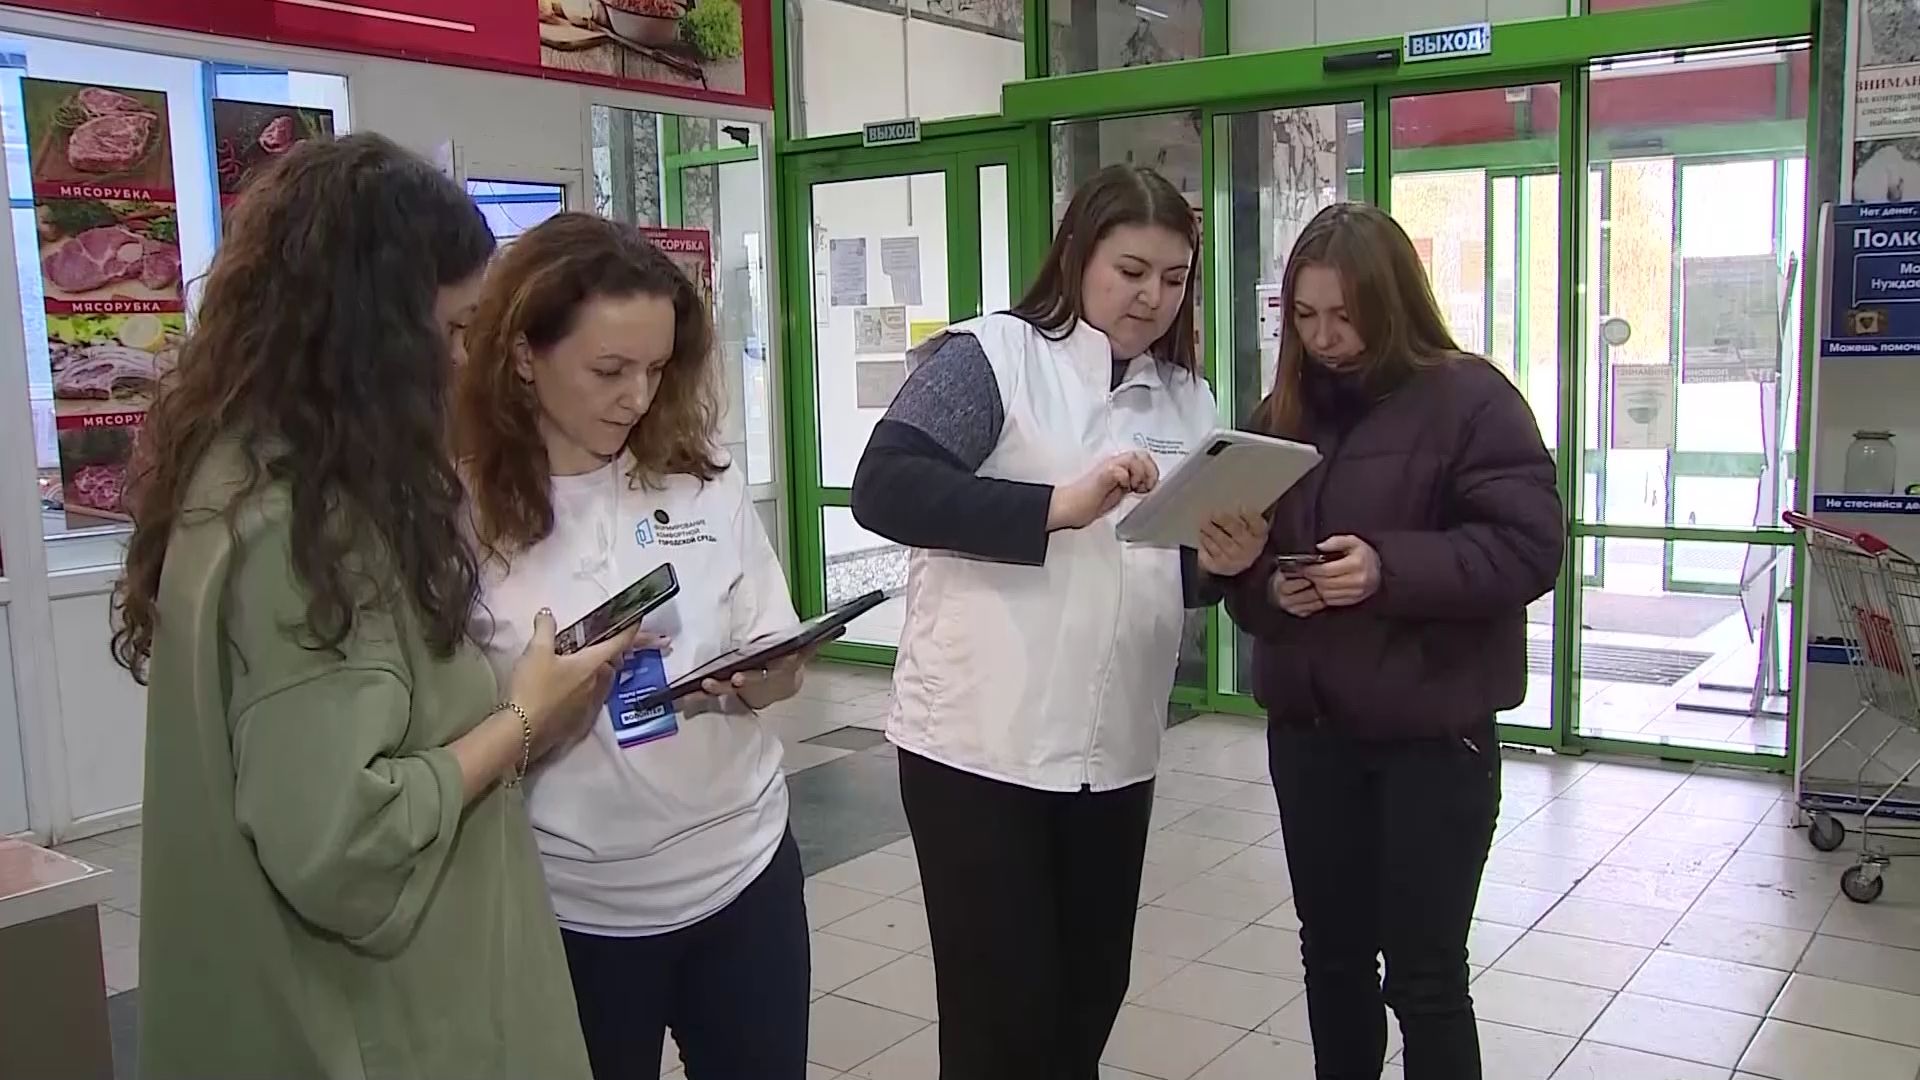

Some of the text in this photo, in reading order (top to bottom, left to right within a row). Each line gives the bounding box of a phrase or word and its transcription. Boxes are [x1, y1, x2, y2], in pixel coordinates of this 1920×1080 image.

[1412, 30, 1483, 55] ВЫХОД
[868, 123, 914, 141] ВЫХОД
[60, 186, 151, 199] МЯСОРУБКА
[1860, 207, 1917, 216] Нет денег,
[1853, 228, 1920, 248] Полк
[72, 302, 161, 312] МЯСОРУБКА
[1829, 343, 1879, 352] Можешь
[1826, 498, 1841, 508] Не
[1844, 500, 1902, 509] стесняйся
